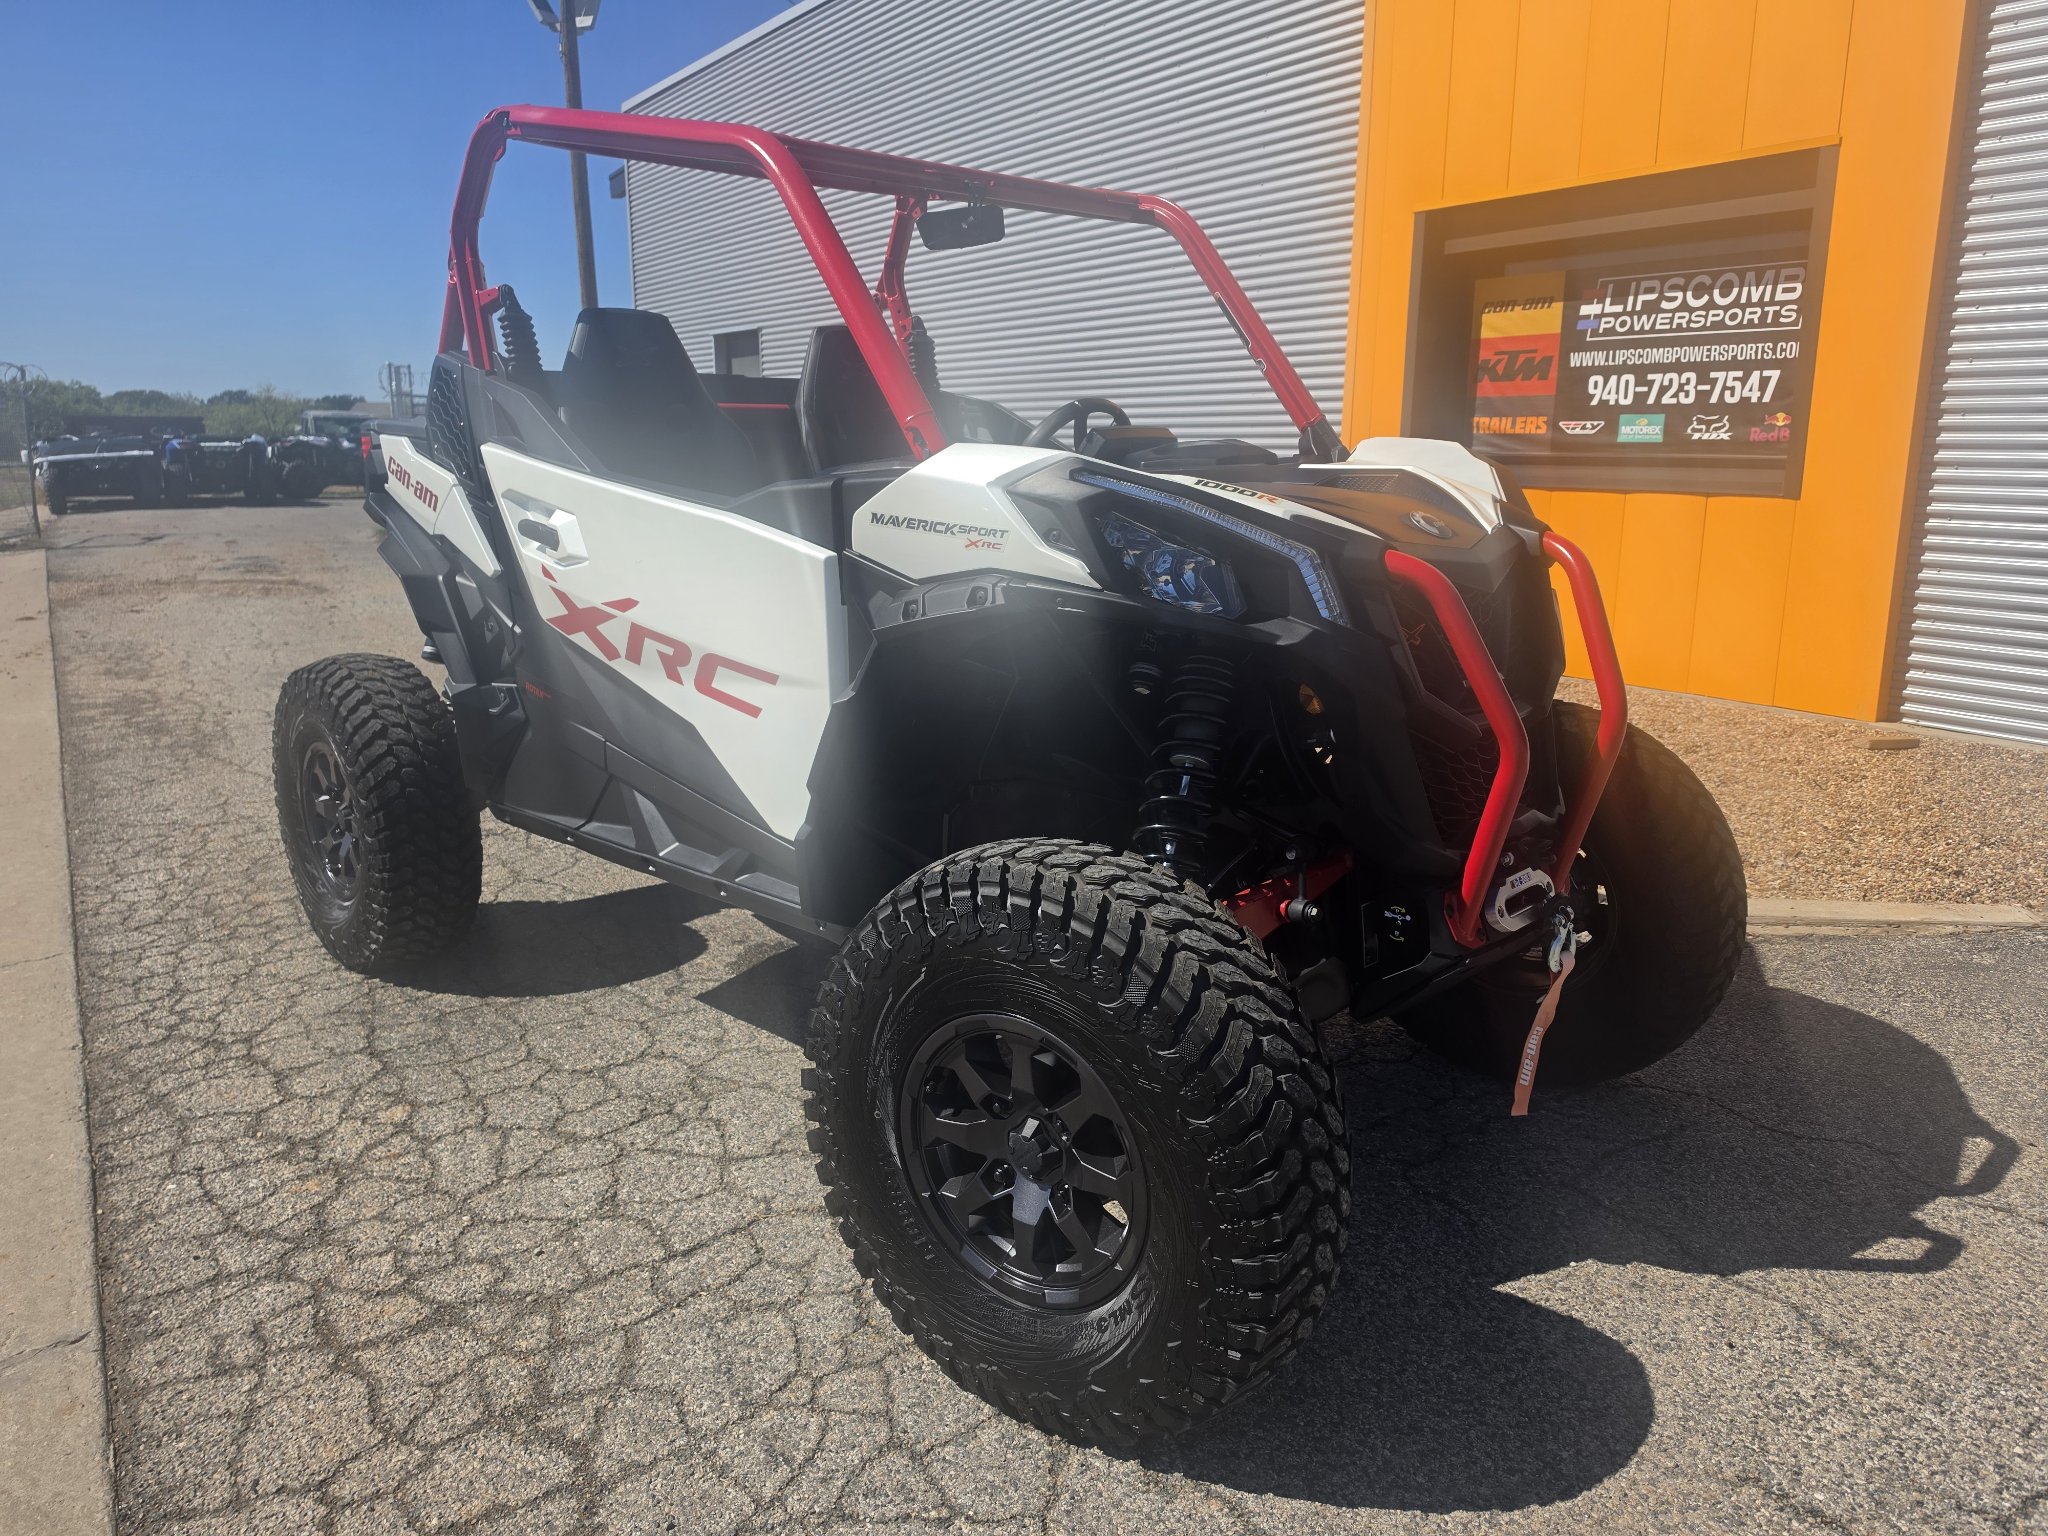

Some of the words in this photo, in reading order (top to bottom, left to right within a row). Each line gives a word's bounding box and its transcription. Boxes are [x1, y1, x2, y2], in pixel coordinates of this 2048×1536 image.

[1603, 267, 1806, 314] LIPSCOMB
[1599, 304, 1799, 333] POWERSPORTS
[1473, 349, 1554, 383] KTM
[1570, 341, 1800, 368] WWW.LIPSCOMBPOWERSPORTS.CO
[1588, 369, 1781, 406] 940-723-7547
[1472, 416, 1547, 434] TRAILERS
[1621, 425, 1662, 435] MOTOREX
[1750, 427, 1777, 442] Red
[388, 455, 439, 513] can-am
[1194, 479, 1279, 504] 1000R
[541, 563, 780, 719] XRC
[1519, 1025, 1544, 1086] can-am
